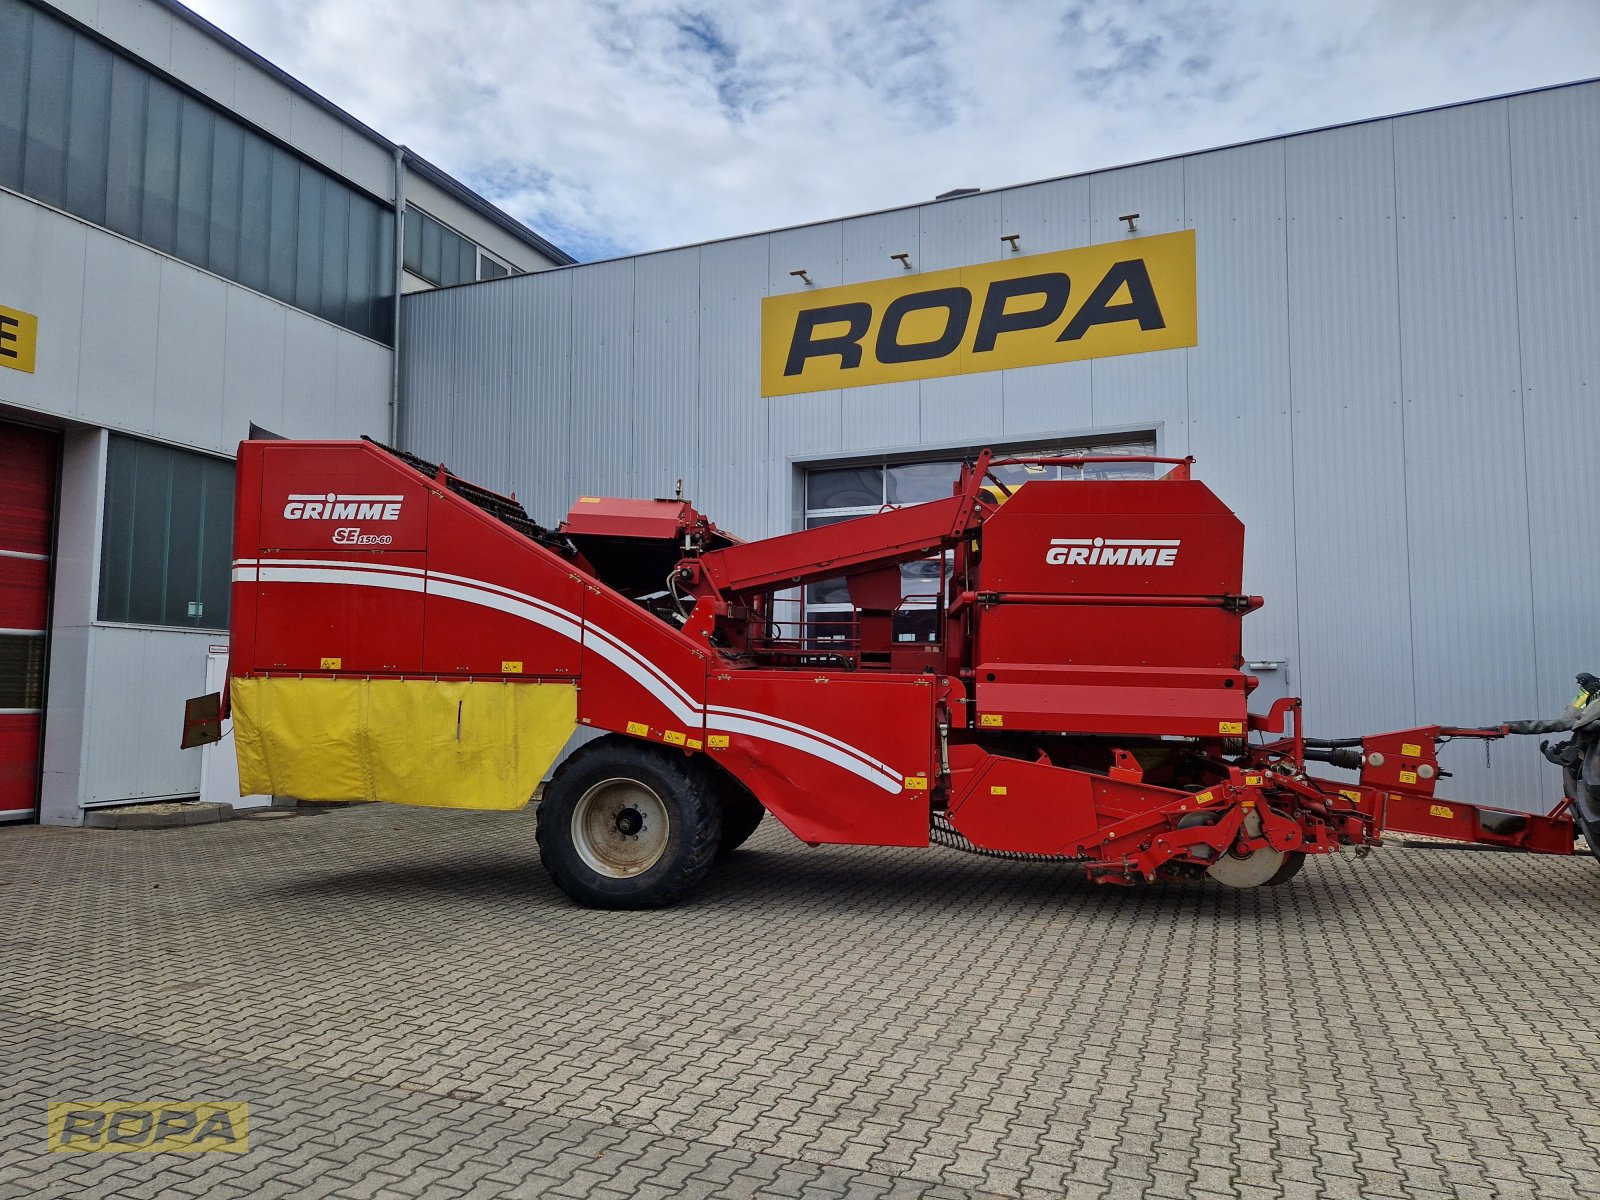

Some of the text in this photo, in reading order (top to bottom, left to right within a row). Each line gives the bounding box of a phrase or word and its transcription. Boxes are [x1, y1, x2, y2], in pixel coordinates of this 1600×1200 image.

[783, 258, 1167, 376] ROPA
[283, 493, 402, 521] GRIMME
[333, 528, 392, 544] SE 150-60
[1045, 537, 1179, 566] GRIMME
